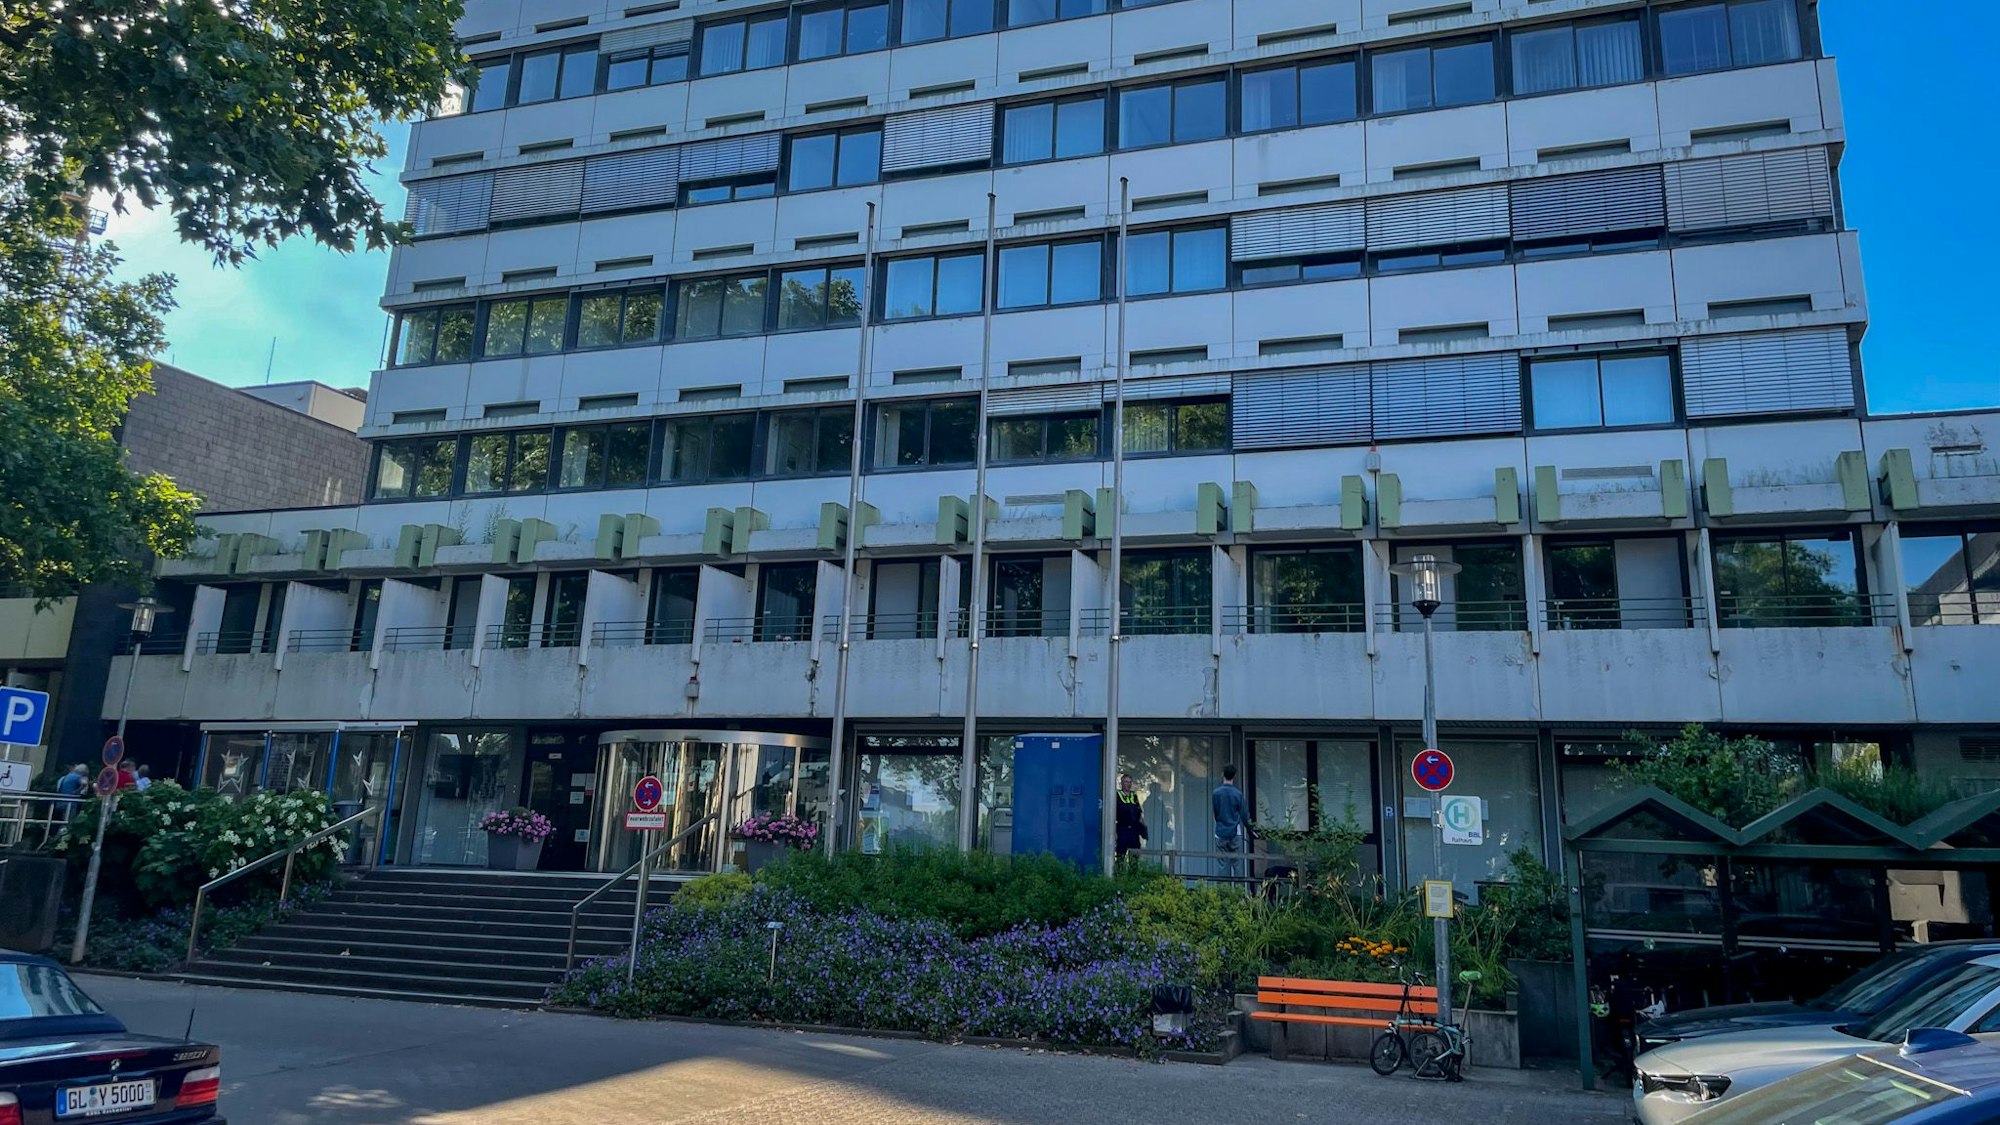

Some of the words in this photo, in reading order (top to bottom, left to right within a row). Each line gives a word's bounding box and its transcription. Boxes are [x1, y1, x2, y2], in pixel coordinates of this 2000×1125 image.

[3, 696, 35, 736] P
[1453, 805, 1470, 824] H
[68, 1091, 88, 1110] GL
[99, 1087, 107, 1106] Y
[111, 1083, 144, 1104] 5000
